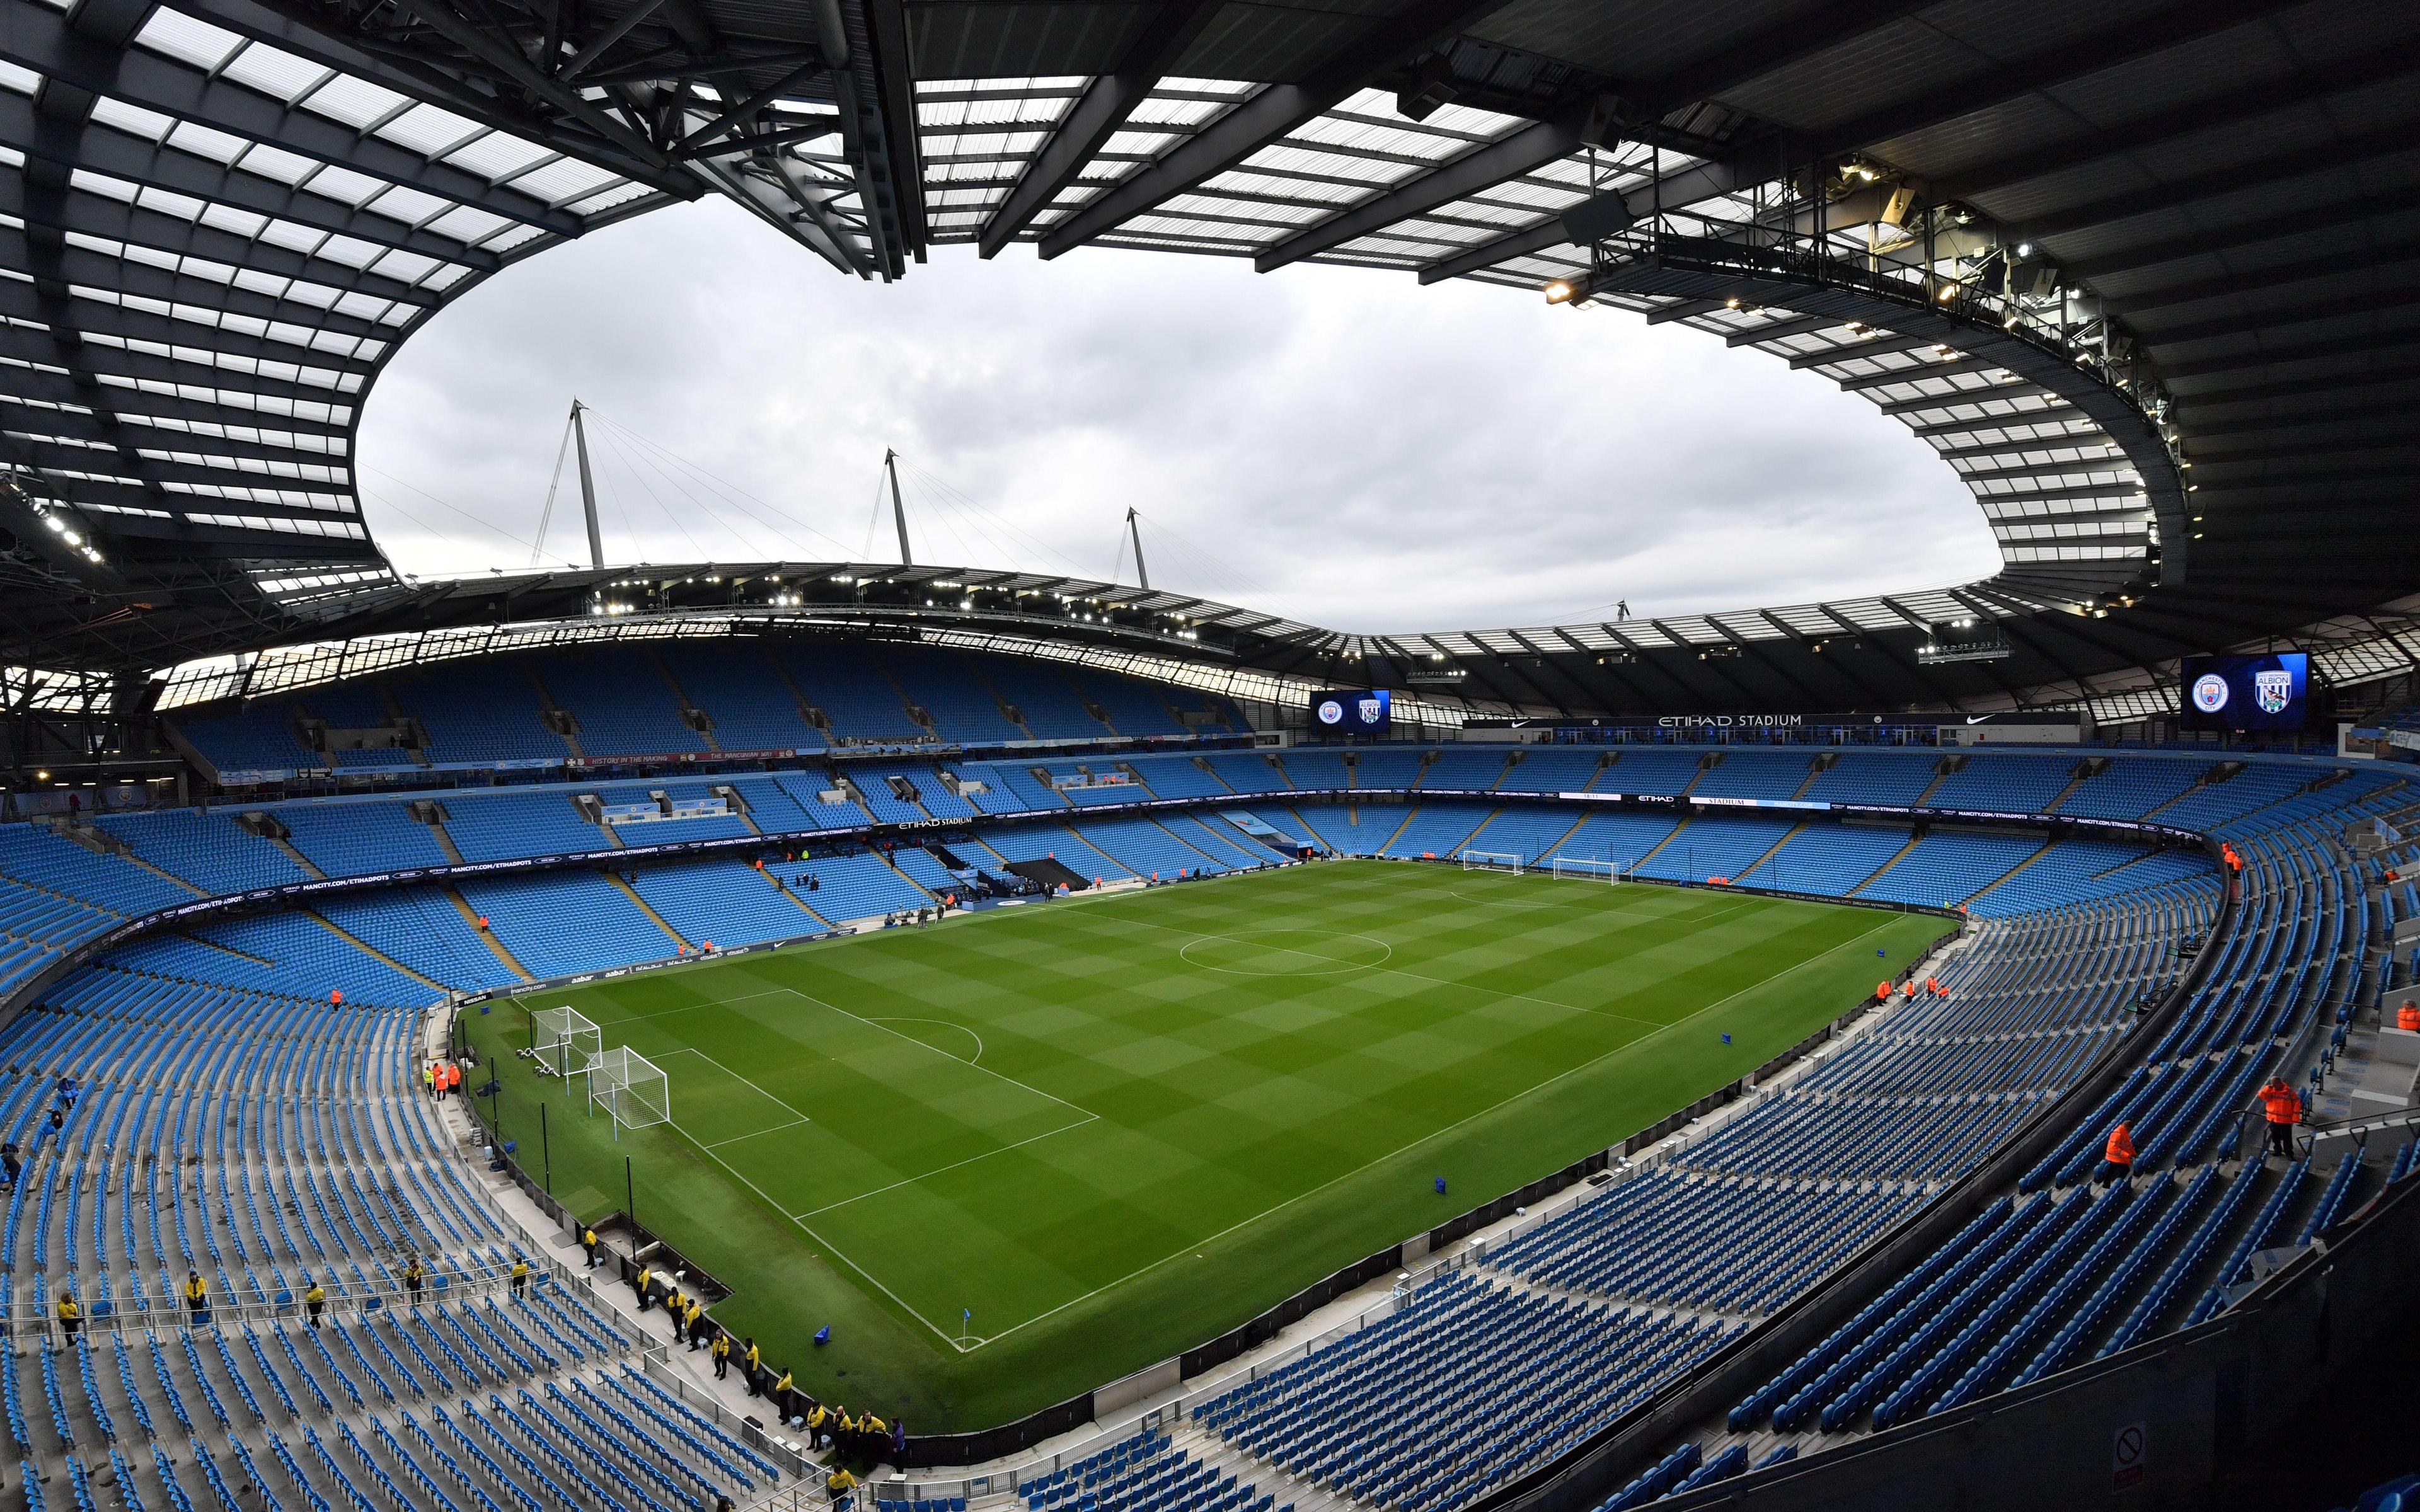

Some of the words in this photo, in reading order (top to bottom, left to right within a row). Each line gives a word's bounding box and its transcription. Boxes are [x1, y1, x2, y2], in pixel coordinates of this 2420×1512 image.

[2196, 676, 2225, 689] MANCHESTER
[1658, 716, 1732, 726] ETIHAD
[1739, 715, 1801, 726] STADIUM
[1958, 811, 2027, 820] MANCITY.COM/ETIHADPOTS
[899, 820, 940, 830] ETIHAD
[942, 817, 972, 826] STADIUM
[2077, 818, 2138, 829] MANCITY.COM/ETIHADPOTS
[703, 838, 761, 847] MANCITY.COM/ETIHADPOTS
[587, 847, 658, 859] MANCITY.COM/ETIHADPOTS
[451, 860, 532, 873] MANCITY.COM/ETIHADPOTS
[303, 874, 389, 891] MANCITY.COM/ETIHADPOTS
[605, 969, 627, 978] aabar
[571, 975, 594, 984] aabar
[510, 983, 546, 995] mancity.com
[464, 994, 487, 1005] NISSAN
